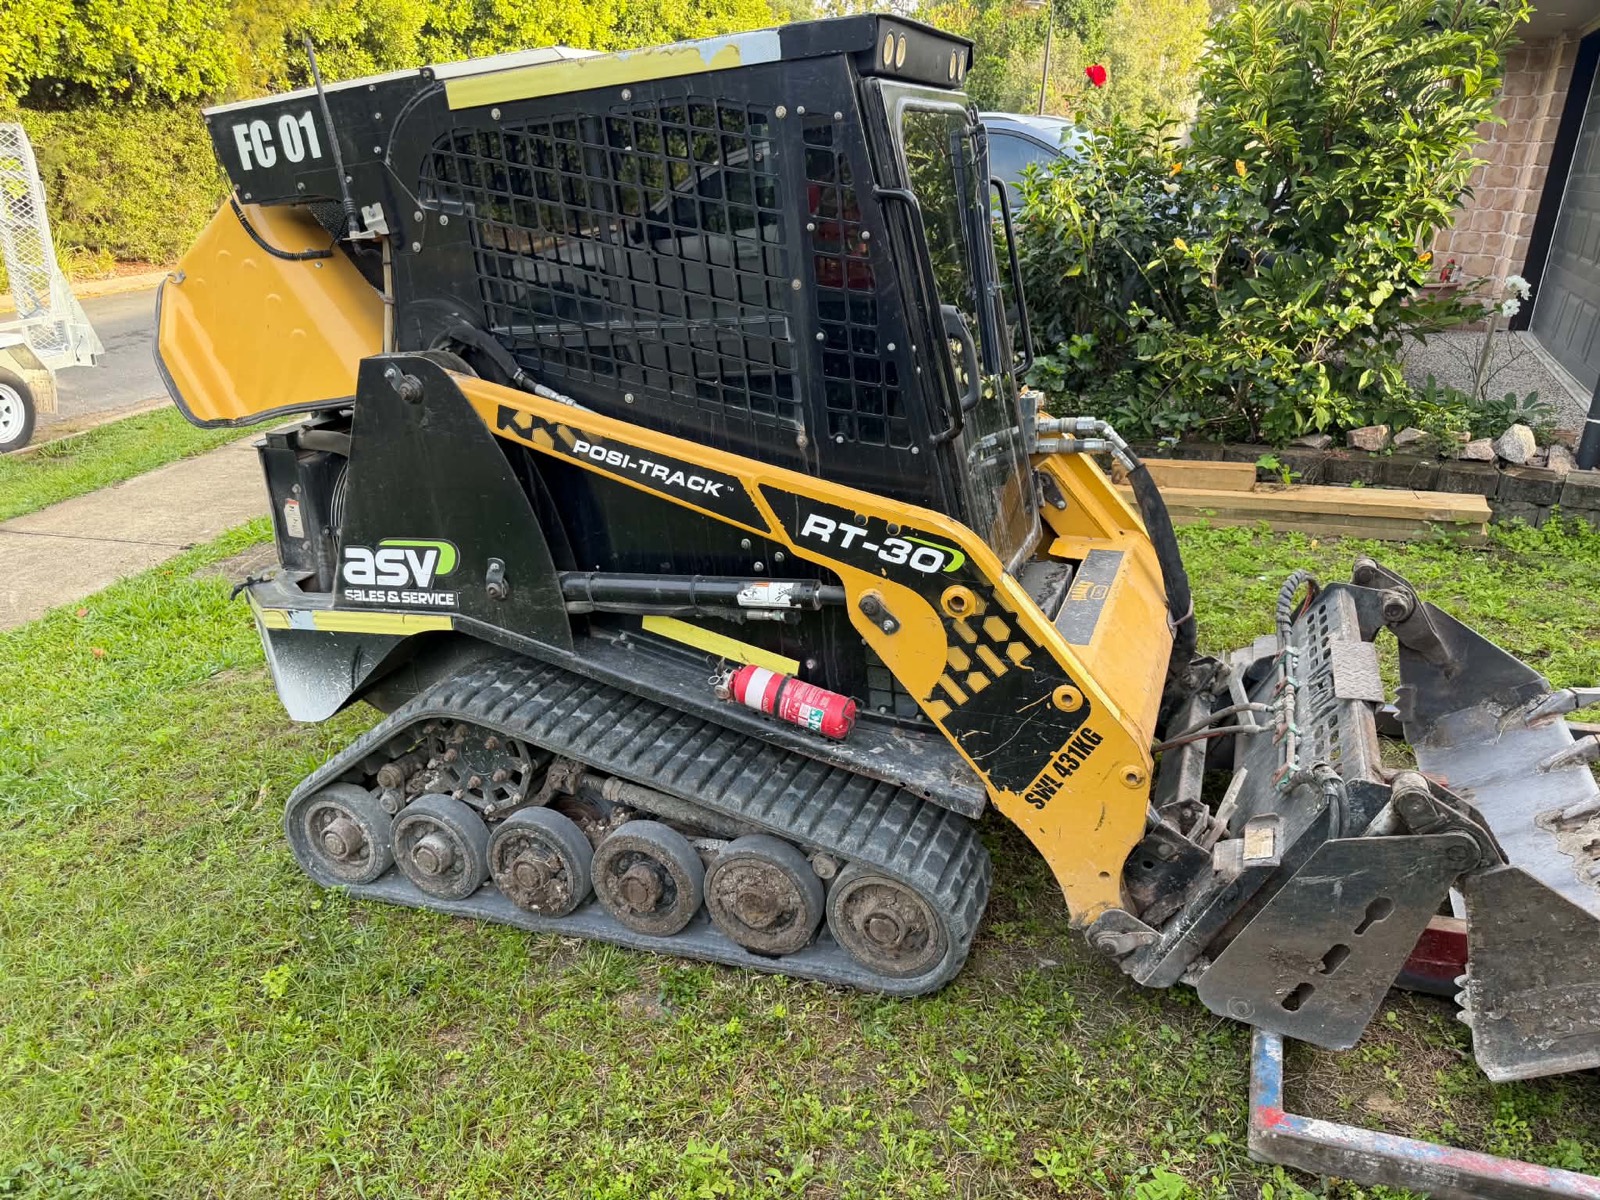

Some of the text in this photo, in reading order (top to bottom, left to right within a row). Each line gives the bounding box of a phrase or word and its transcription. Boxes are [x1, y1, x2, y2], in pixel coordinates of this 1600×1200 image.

[232, 110, 322, 171] FC 01
[573, 439, 725, 498] POSI-TRACK
[801, 513, 945, 574] RT-30
[387, 591, 400, 603] &
[401, 591, 455, 605] SERVICE
[1024, 727, 1104, 810] SWL 431KG
